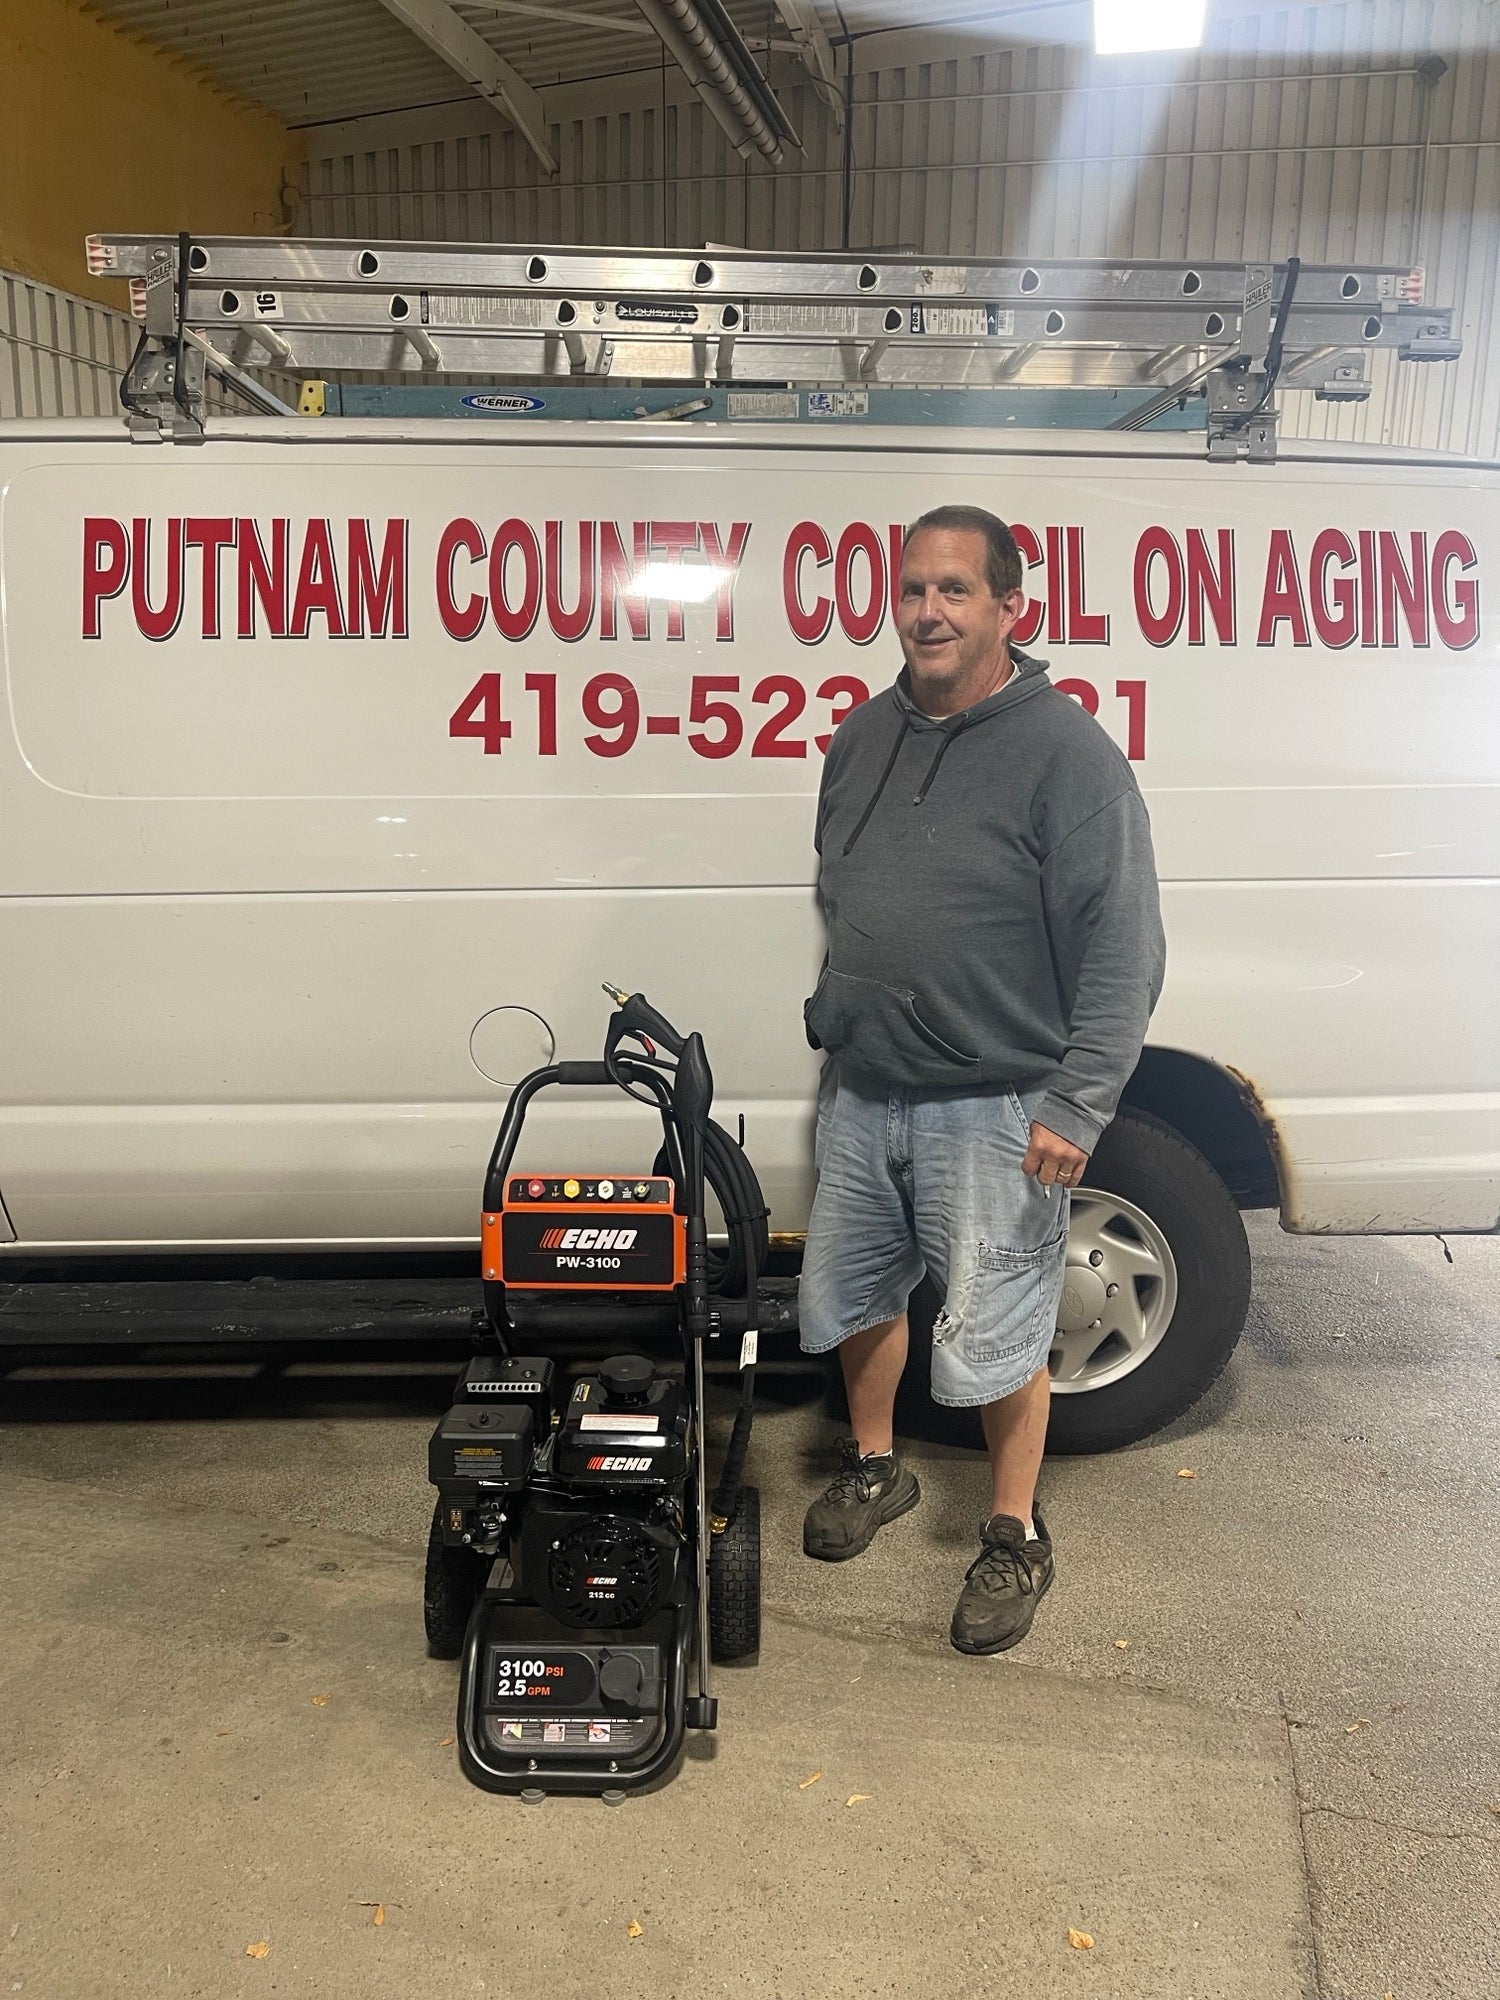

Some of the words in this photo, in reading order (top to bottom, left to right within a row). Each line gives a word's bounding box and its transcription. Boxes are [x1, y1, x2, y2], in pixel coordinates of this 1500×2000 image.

[477, 398, 529, 408] WERNER
[82, 517, 409, 641] PUTNAM
[436, 518, 752, 642] COUNTY
[1133, 525, 1237, 647] ON
[1256, 528, 1480, 650] AGING
[559, 1228, 638, 1250] ECHO
[556, 1256, 621, 1269] PW-3100
[600, 1456, 653, 1471] ECHO
[592, 1577, 618, 1585] ECHO
[588, 1591, 604, 1599] 212
[499, 1660, 545, 1677] 3100
[545, 1666, 564, 1677] PSI
[497, 1679, 527, 1696] 2.5
[527, 1686, 551, 1696] GPM
